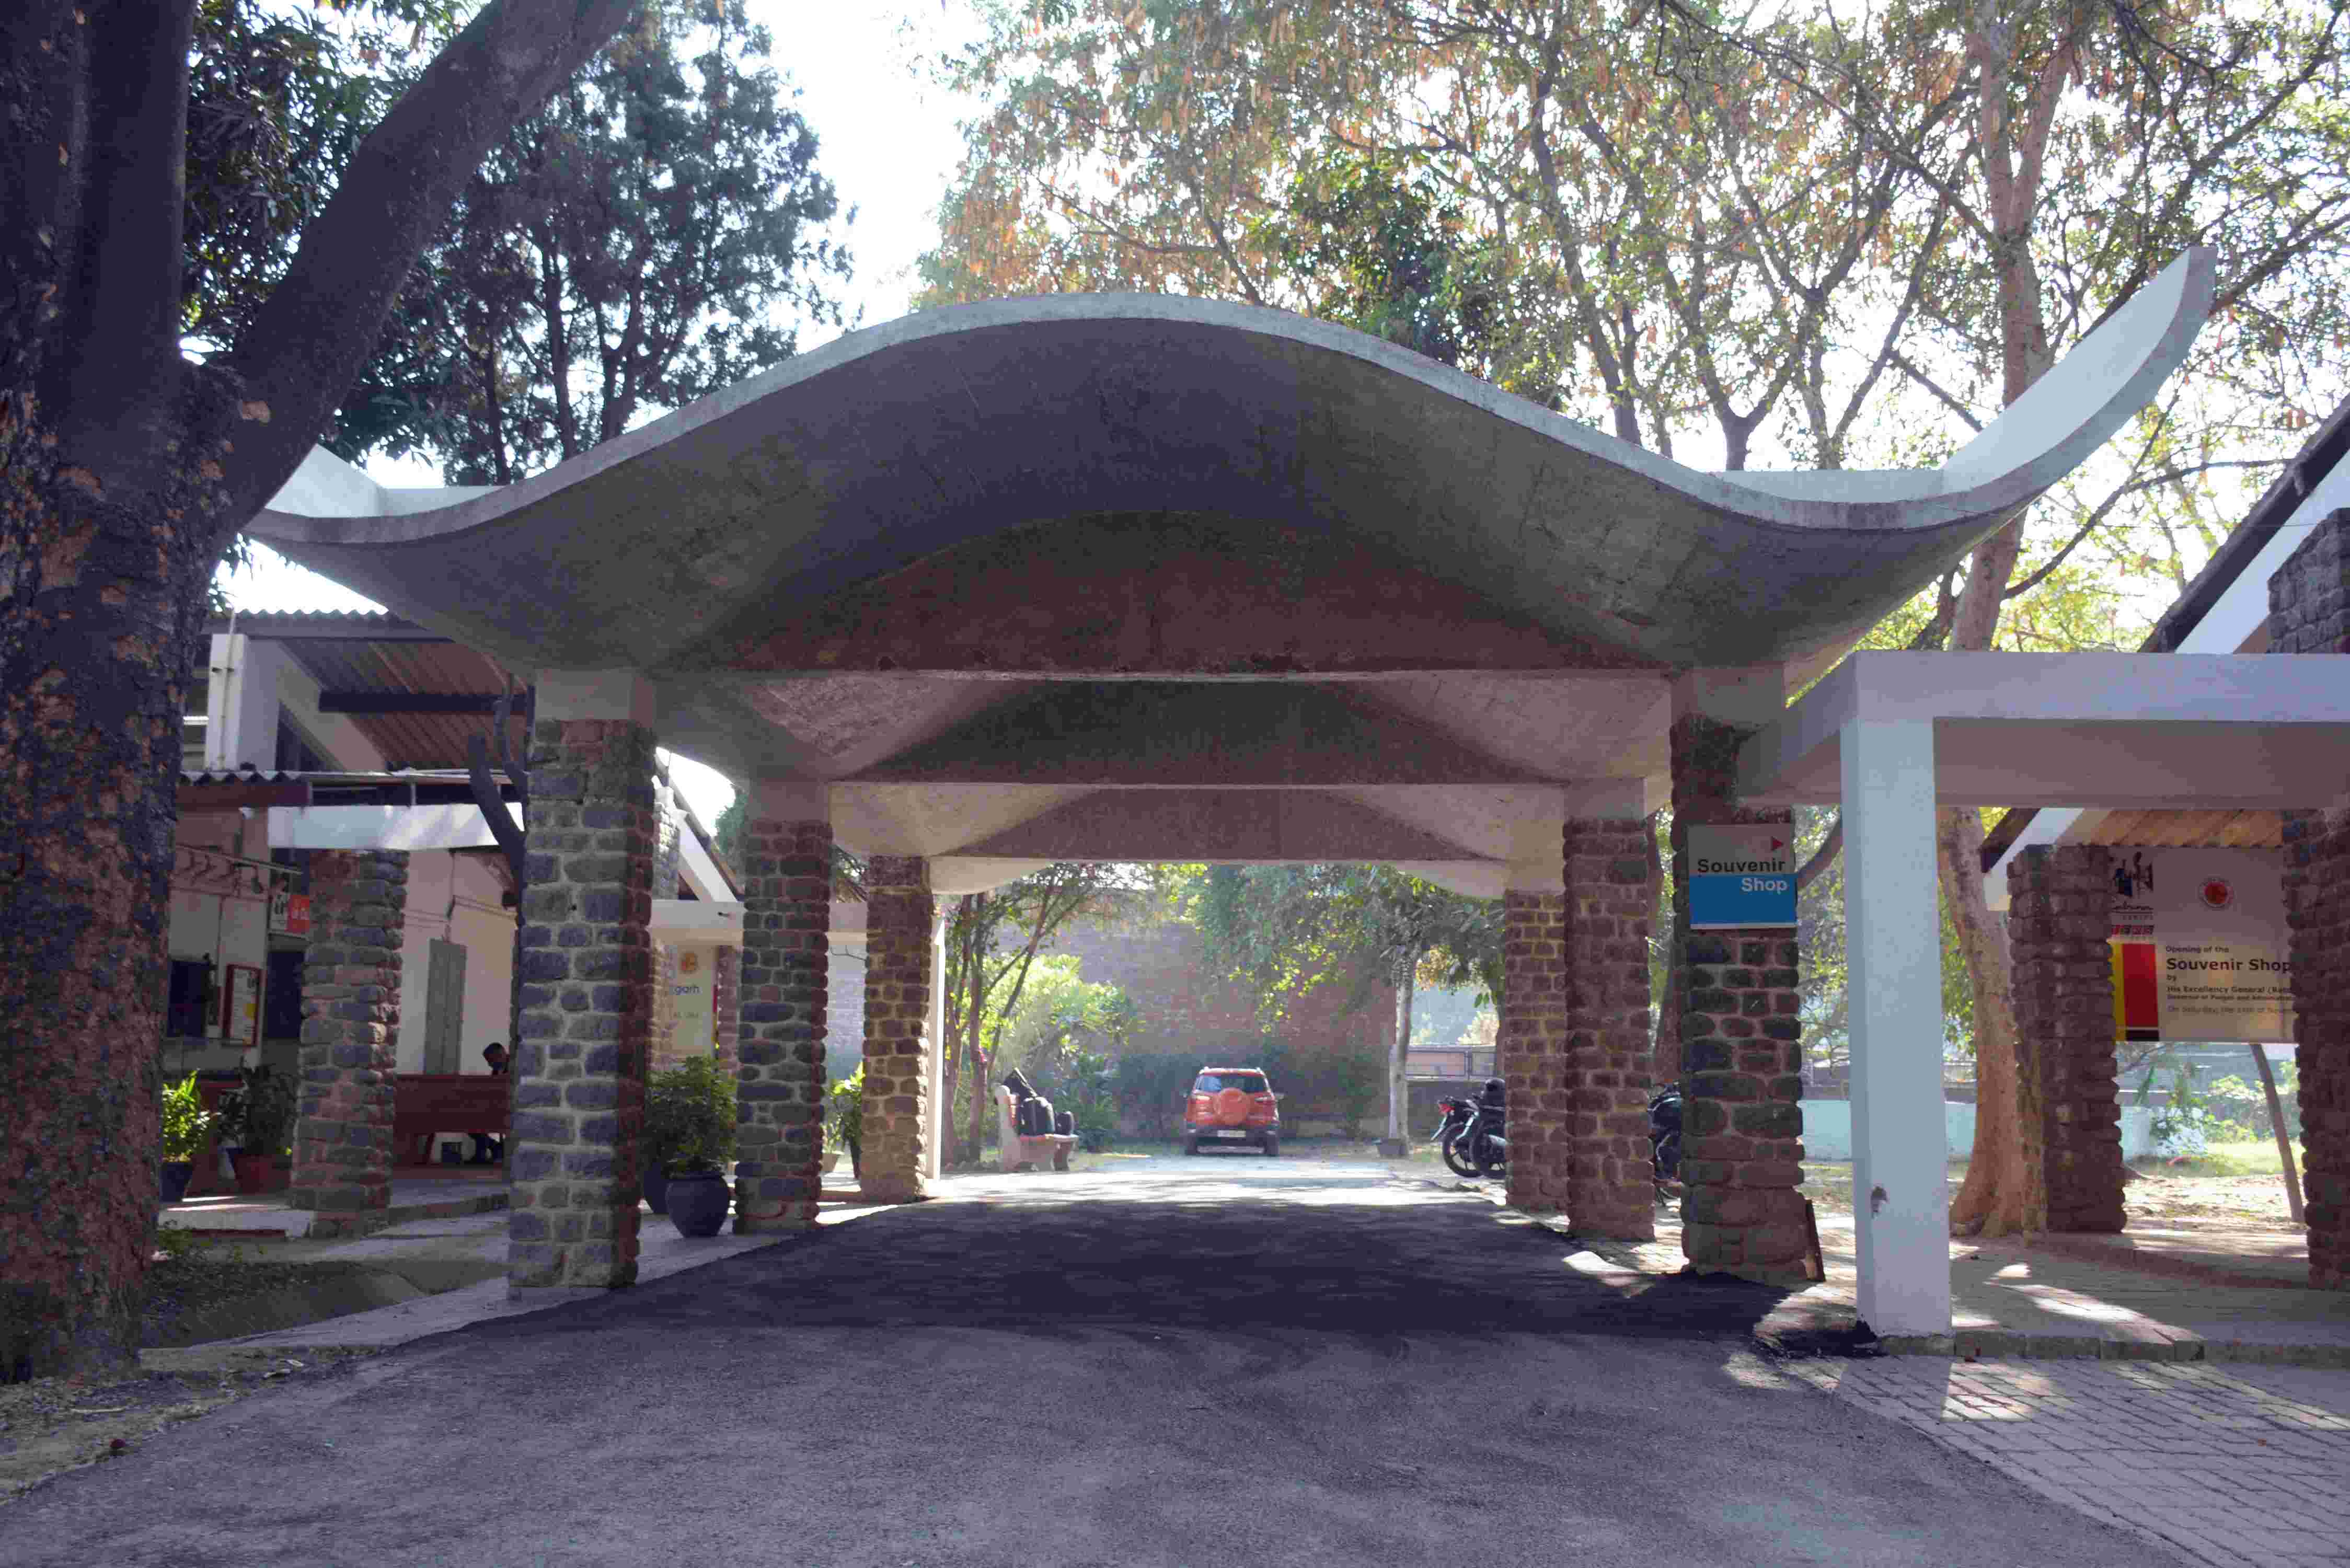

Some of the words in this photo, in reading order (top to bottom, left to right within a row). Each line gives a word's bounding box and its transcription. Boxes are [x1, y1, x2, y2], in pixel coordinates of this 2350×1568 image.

[1697, 858, 1785, 873] Souvenir
[1741, 878, 1788, 895] Shop
[2165, 946, 2201, 954] Opening
[2167, 957, 2243, 971] Souvenir
[2249, 958, 2291, 974] Shop
